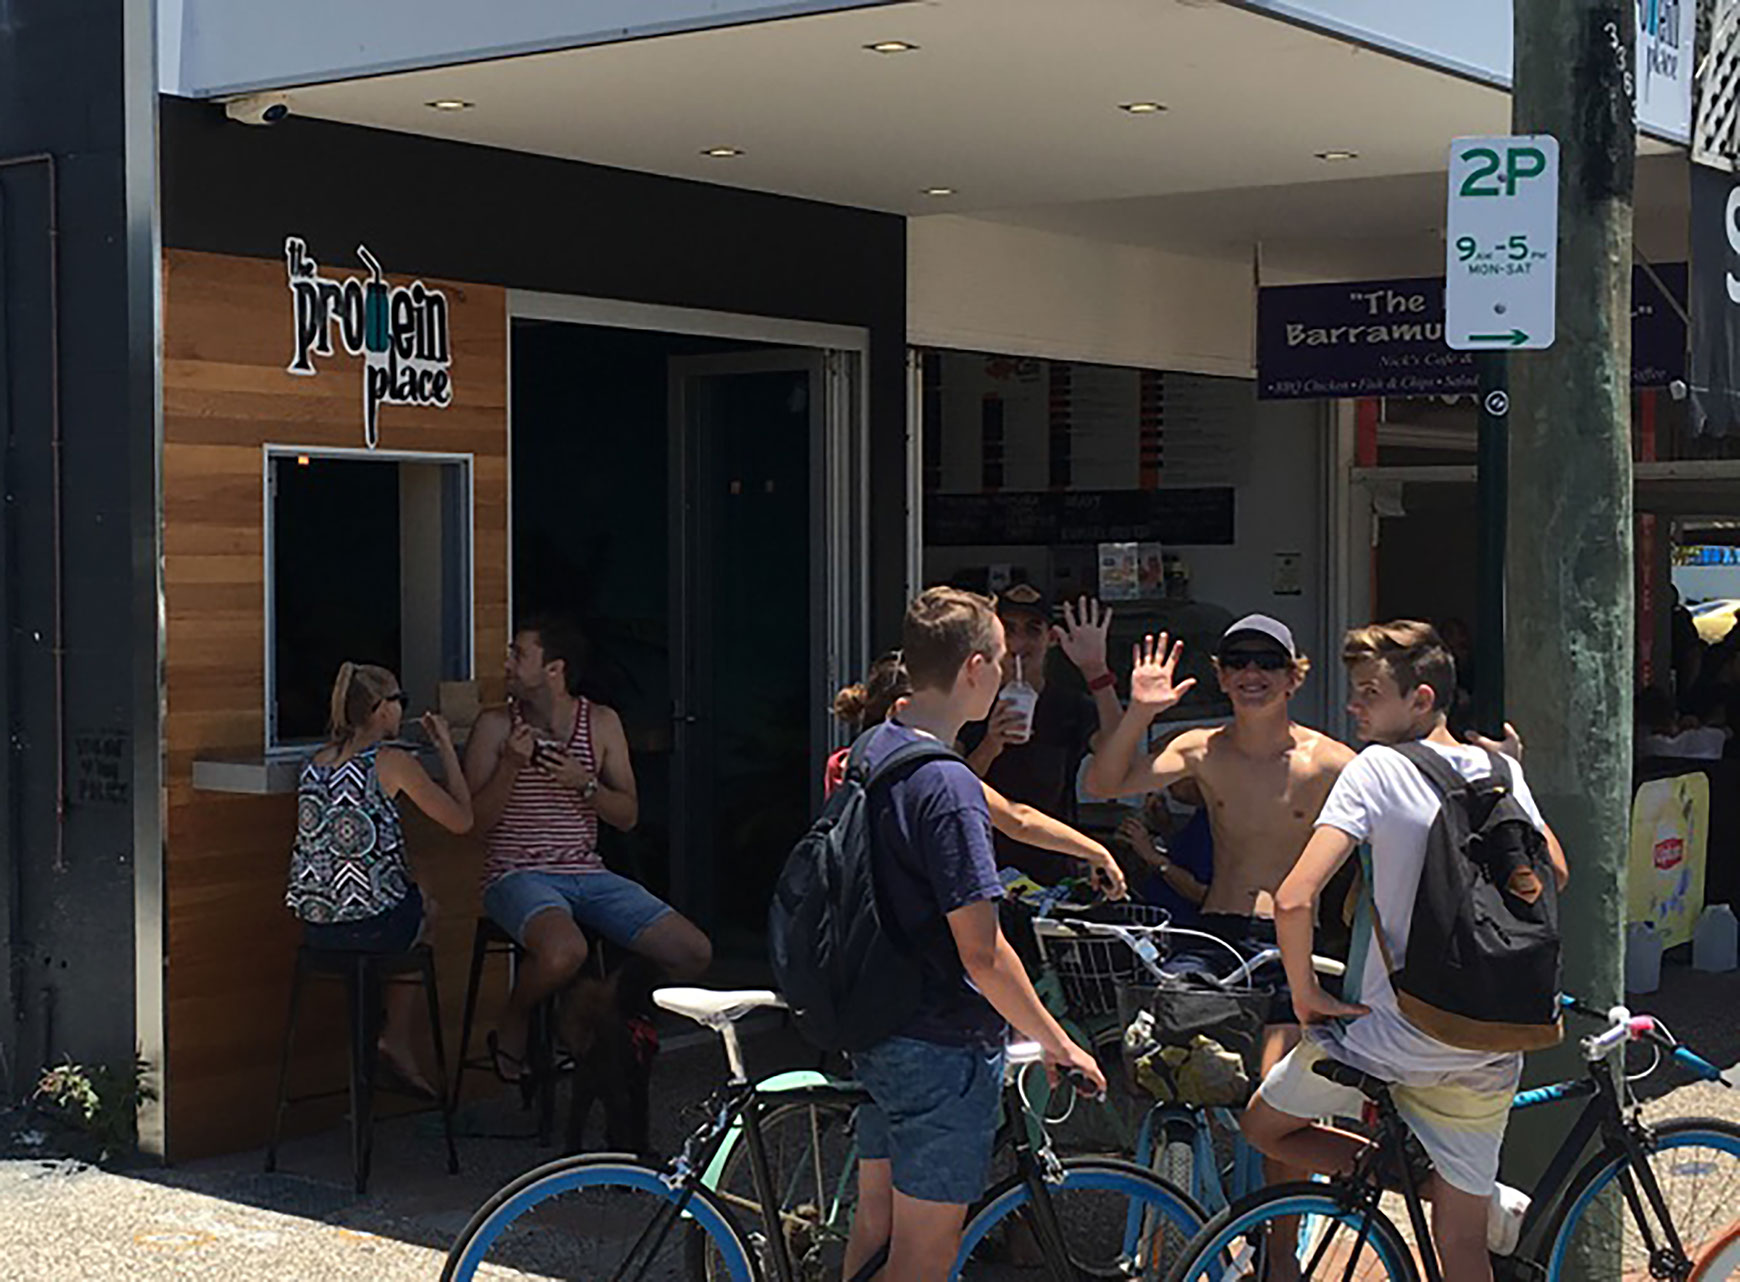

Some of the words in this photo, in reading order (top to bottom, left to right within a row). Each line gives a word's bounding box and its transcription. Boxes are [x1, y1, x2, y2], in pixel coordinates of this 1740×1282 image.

[1459, 147, 1546, 196] 2P
[287, 238, 317, 278] the
[1468, 262, 1533, 276] MON-SAT
[365, 364, 452, 446] place
